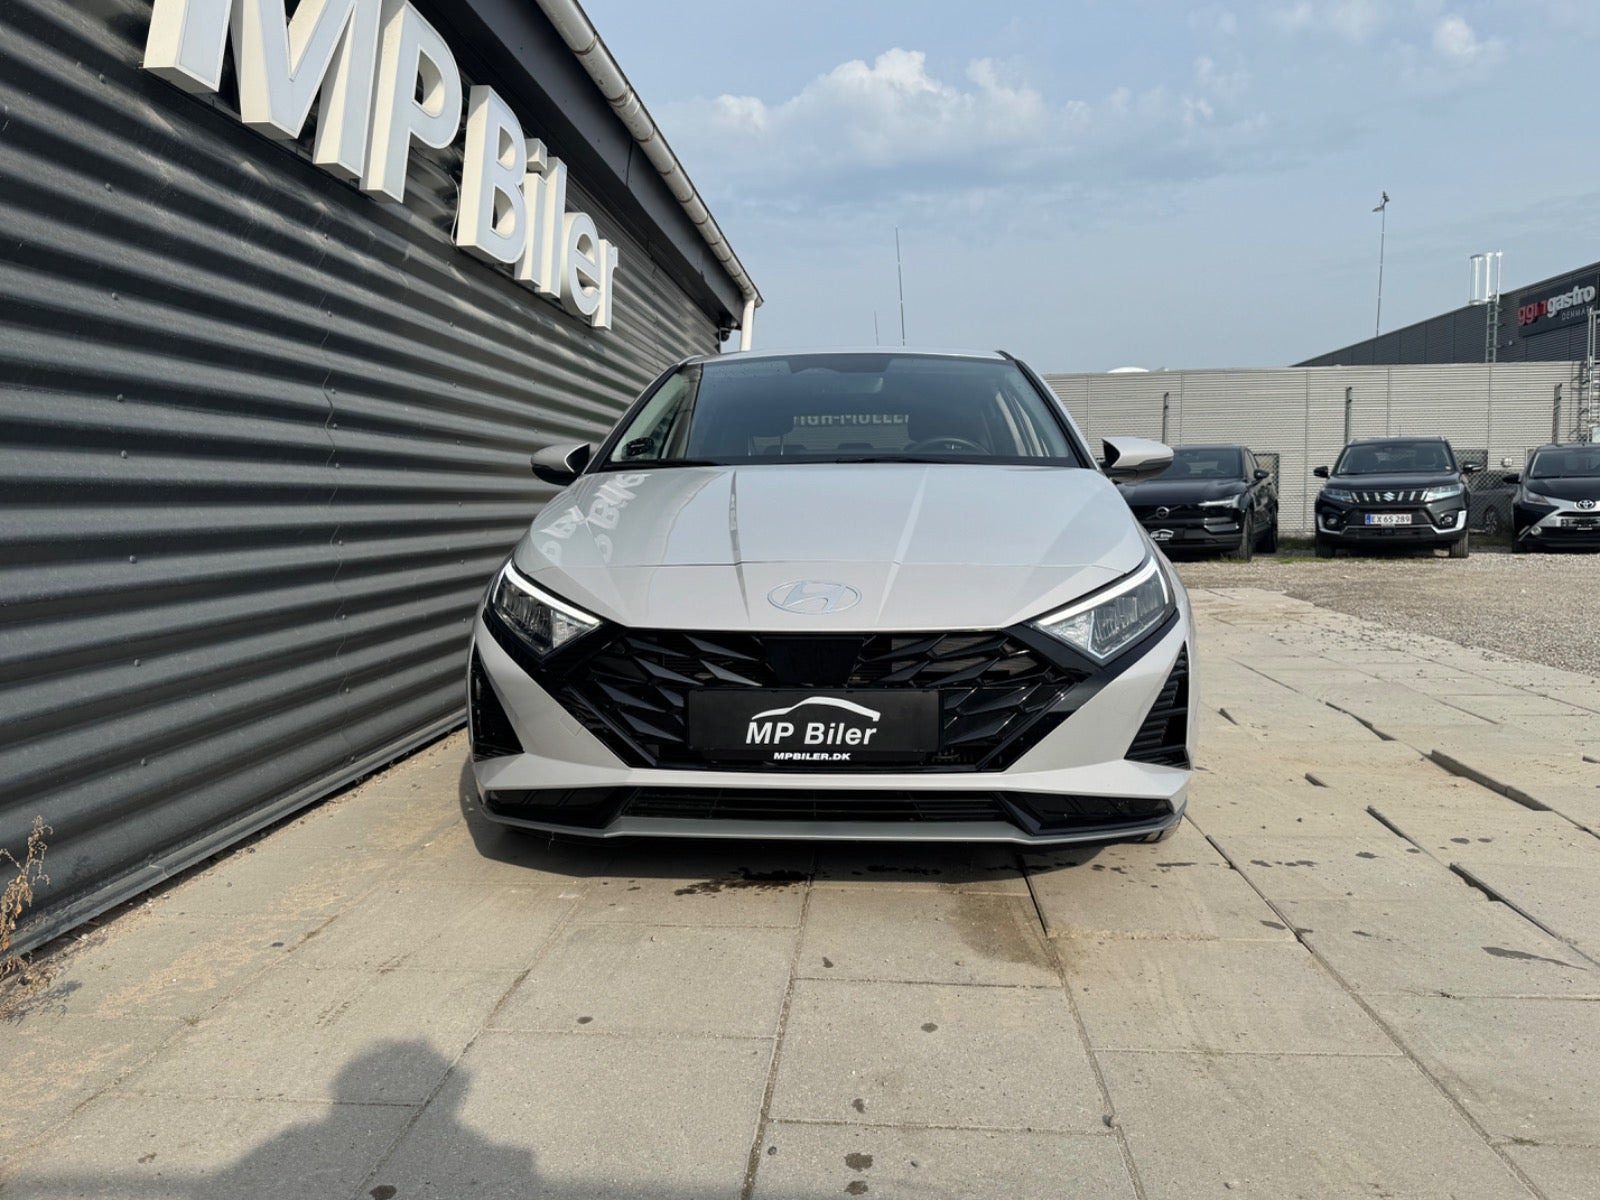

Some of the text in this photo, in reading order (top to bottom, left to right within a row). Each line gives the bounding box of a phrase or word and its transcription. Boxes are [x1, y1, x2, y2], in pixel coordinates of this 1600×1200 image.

[143, 0, 619, 330] MP Biler
[746, 722, 877, 745] MP Biler
[773, 752, 851, 761] MPBILER.DK
